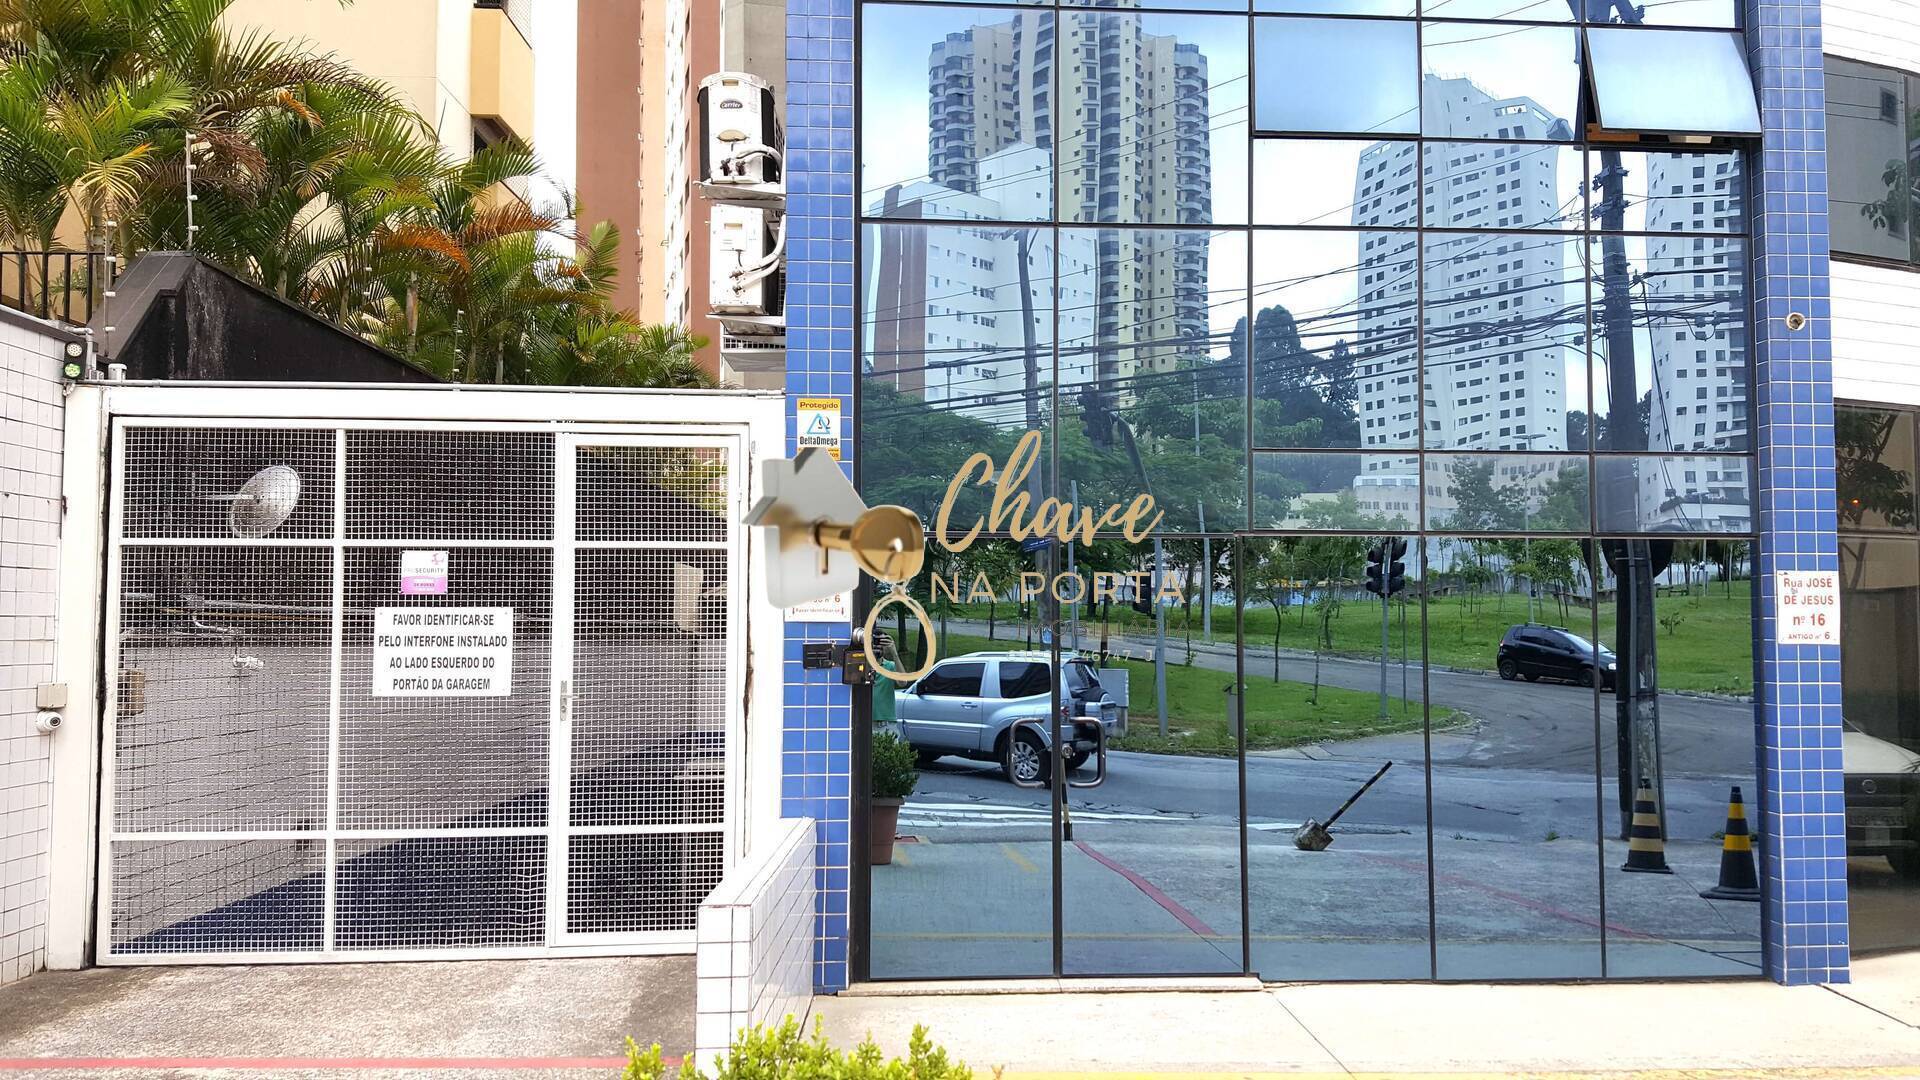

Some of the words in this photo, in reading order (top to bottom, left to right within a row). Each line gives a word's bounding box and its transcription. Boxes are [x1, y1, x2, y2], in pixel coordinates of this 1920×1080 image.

[800, 436, 838, 446] DeltaOmega
[1783, 578, 1803, 588] Rua
[1784, 595, 1797, 605] DE
[1801, 595, 1833, 605] JESUS
[392, 614, 421, 626] FAVOR
[424, 614, 494, 626] IDENTIFICAR-SE
[1810, 613, 1826, 626] 16
[378, 635, 401, 647] PELO
[404, 635, 454, 647] INTERFONE
[457, 635, 507, 647] INSTALADO
[1824, 631, 1830, 640] 6
[389, 657, 402, 669] AO
[404, 657, 428, 669] LADO
[431, 657, 479, 669] ESQUERDO
[482, 657, 495, 669] DO
[392, 675, 429, 690] PORTÃO
[432, 678, 443, 690] DA
[446, 678, 491, 690] GARAGEM
